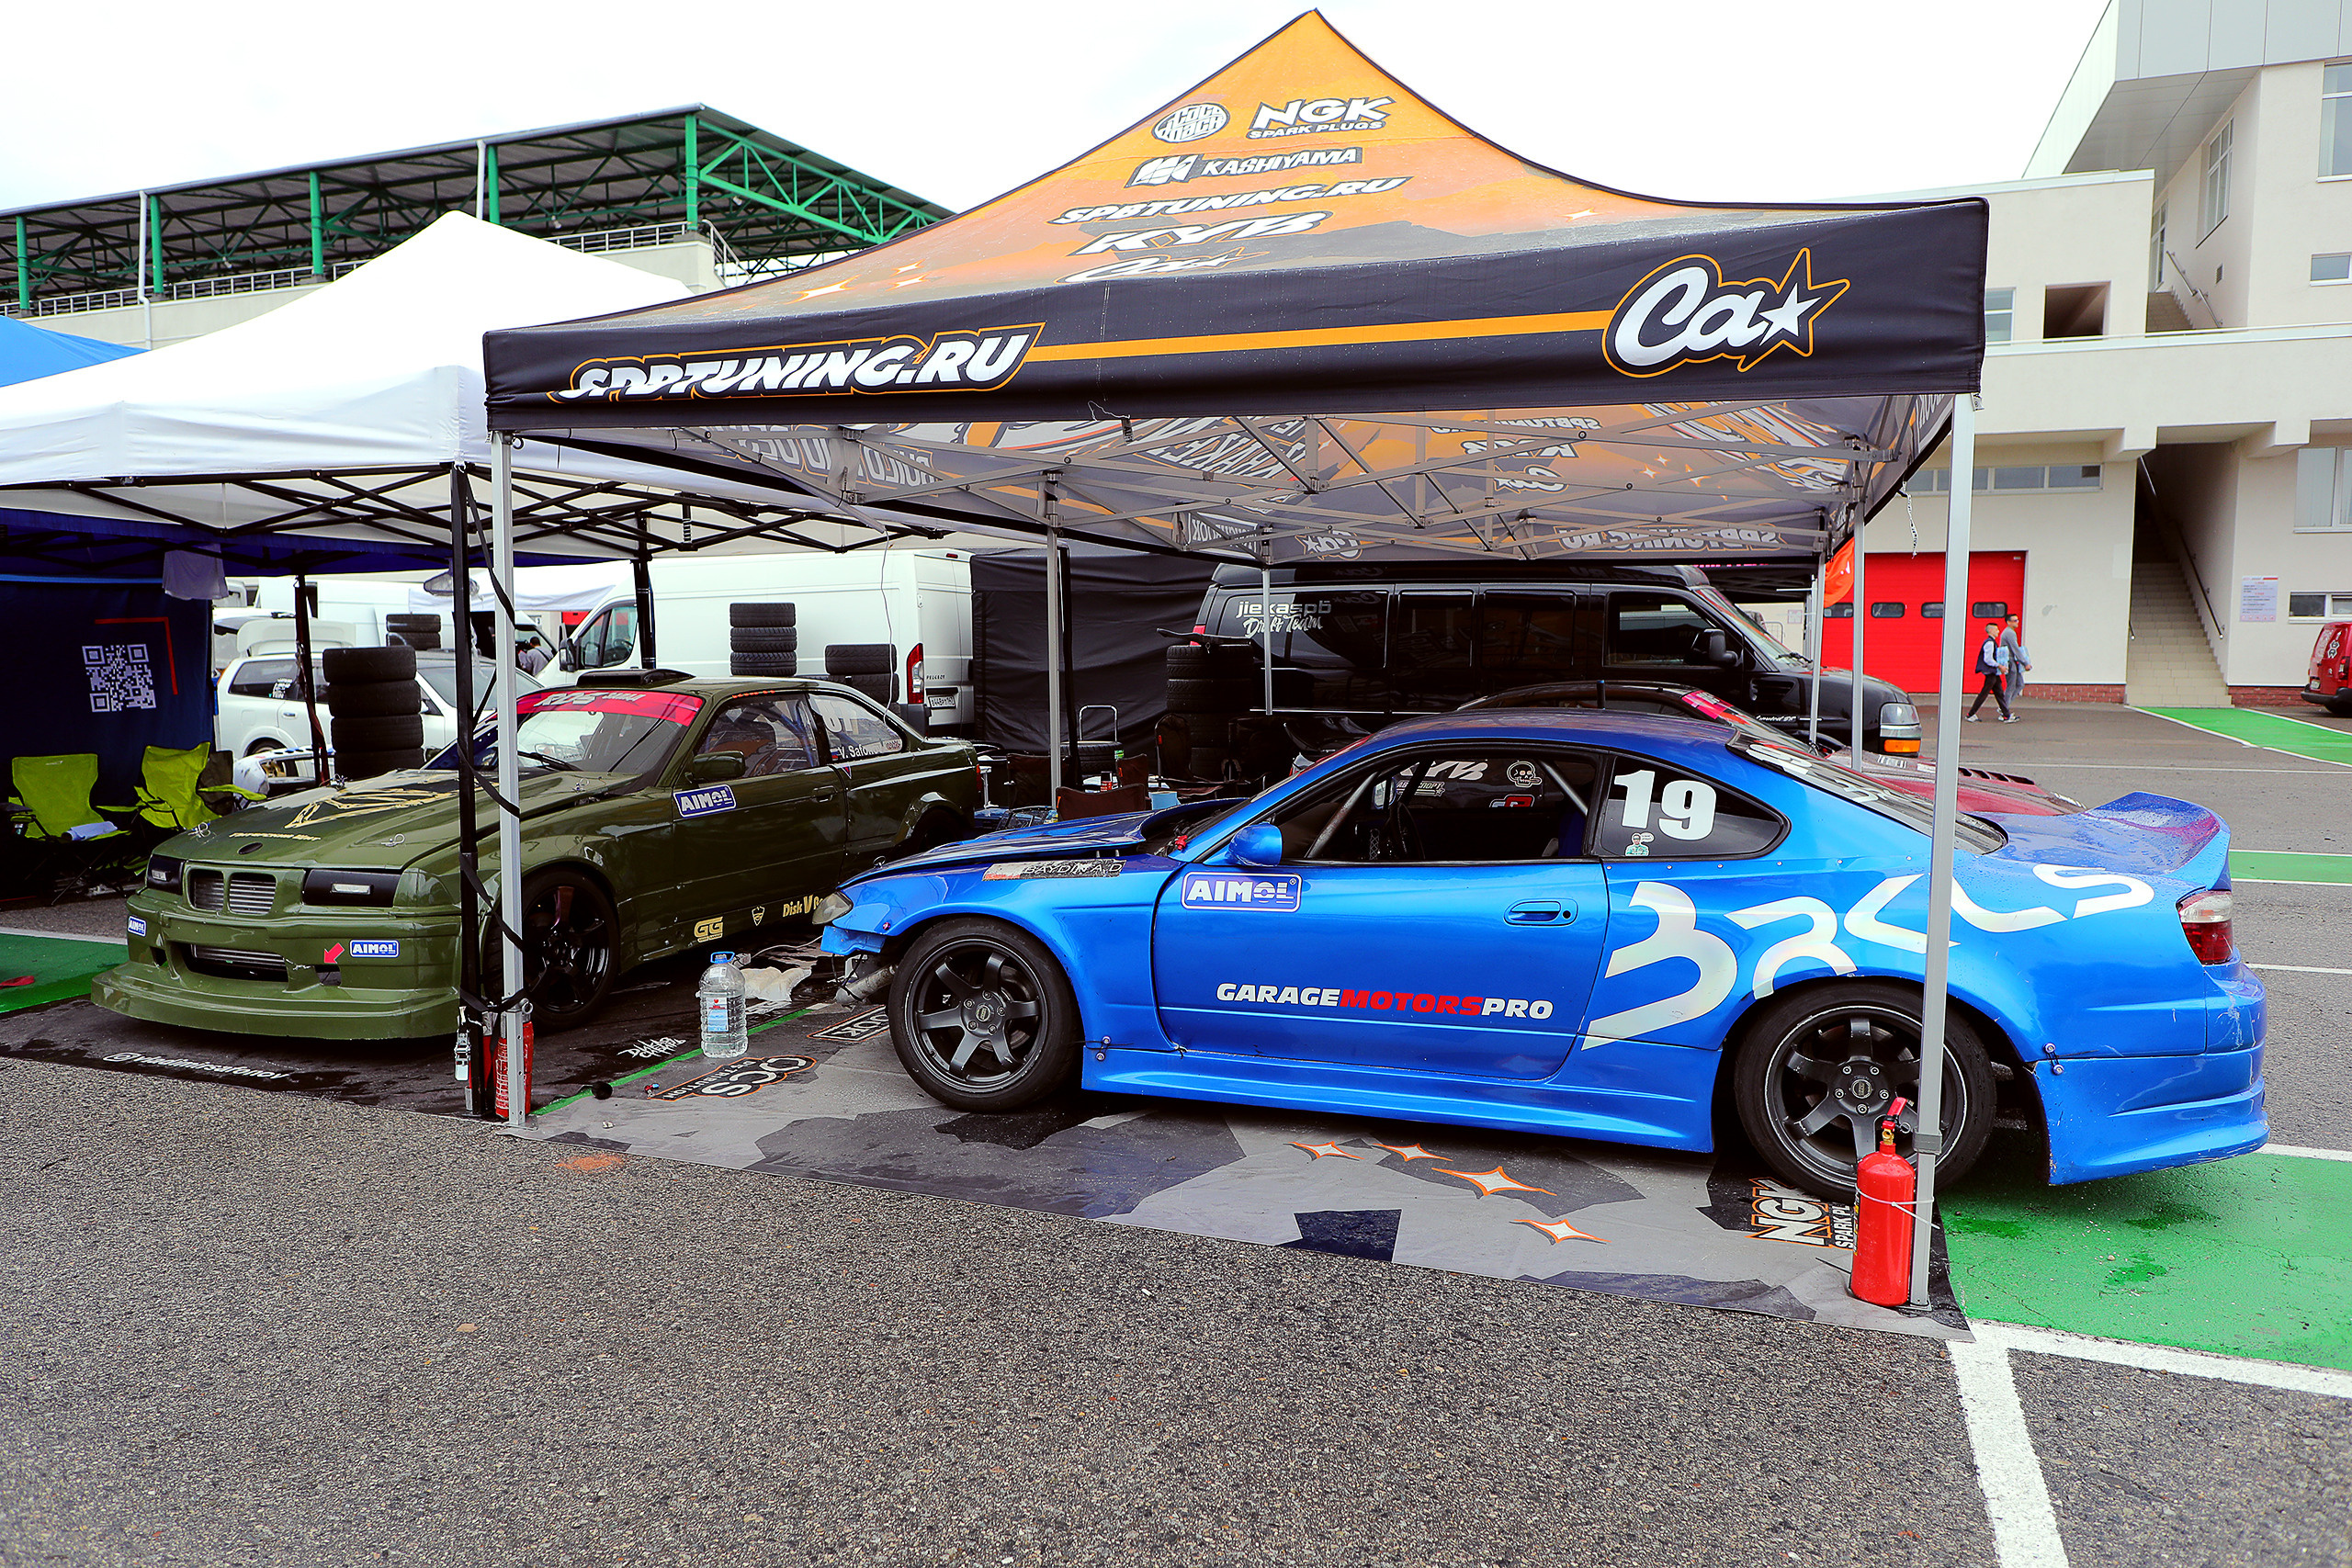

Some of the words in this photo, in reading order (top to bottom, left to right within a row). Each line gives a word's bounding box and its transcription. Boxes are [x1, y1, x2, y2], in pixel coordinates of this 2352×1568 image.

[1253, 98, 1395, 130] NGK
[1249, 125, 1312, 140] SPARK
[1316, 120, 1385, 133] PLUGS
[1202, 148, 1358, 177] KASHIYAMA
[1056, 176, 1408, 224] SPBTUNING.RU
[1075, 210, 1331, 256] KYB
[681, 790, 732, 812] AIMOL
[1614, 770, 1717, 840] 19
[1186, 879, 1295, 904] AIMOL
[353, 942, 397, 955] AIMOL
[1758, 1179, 1826, 1247] NGK
